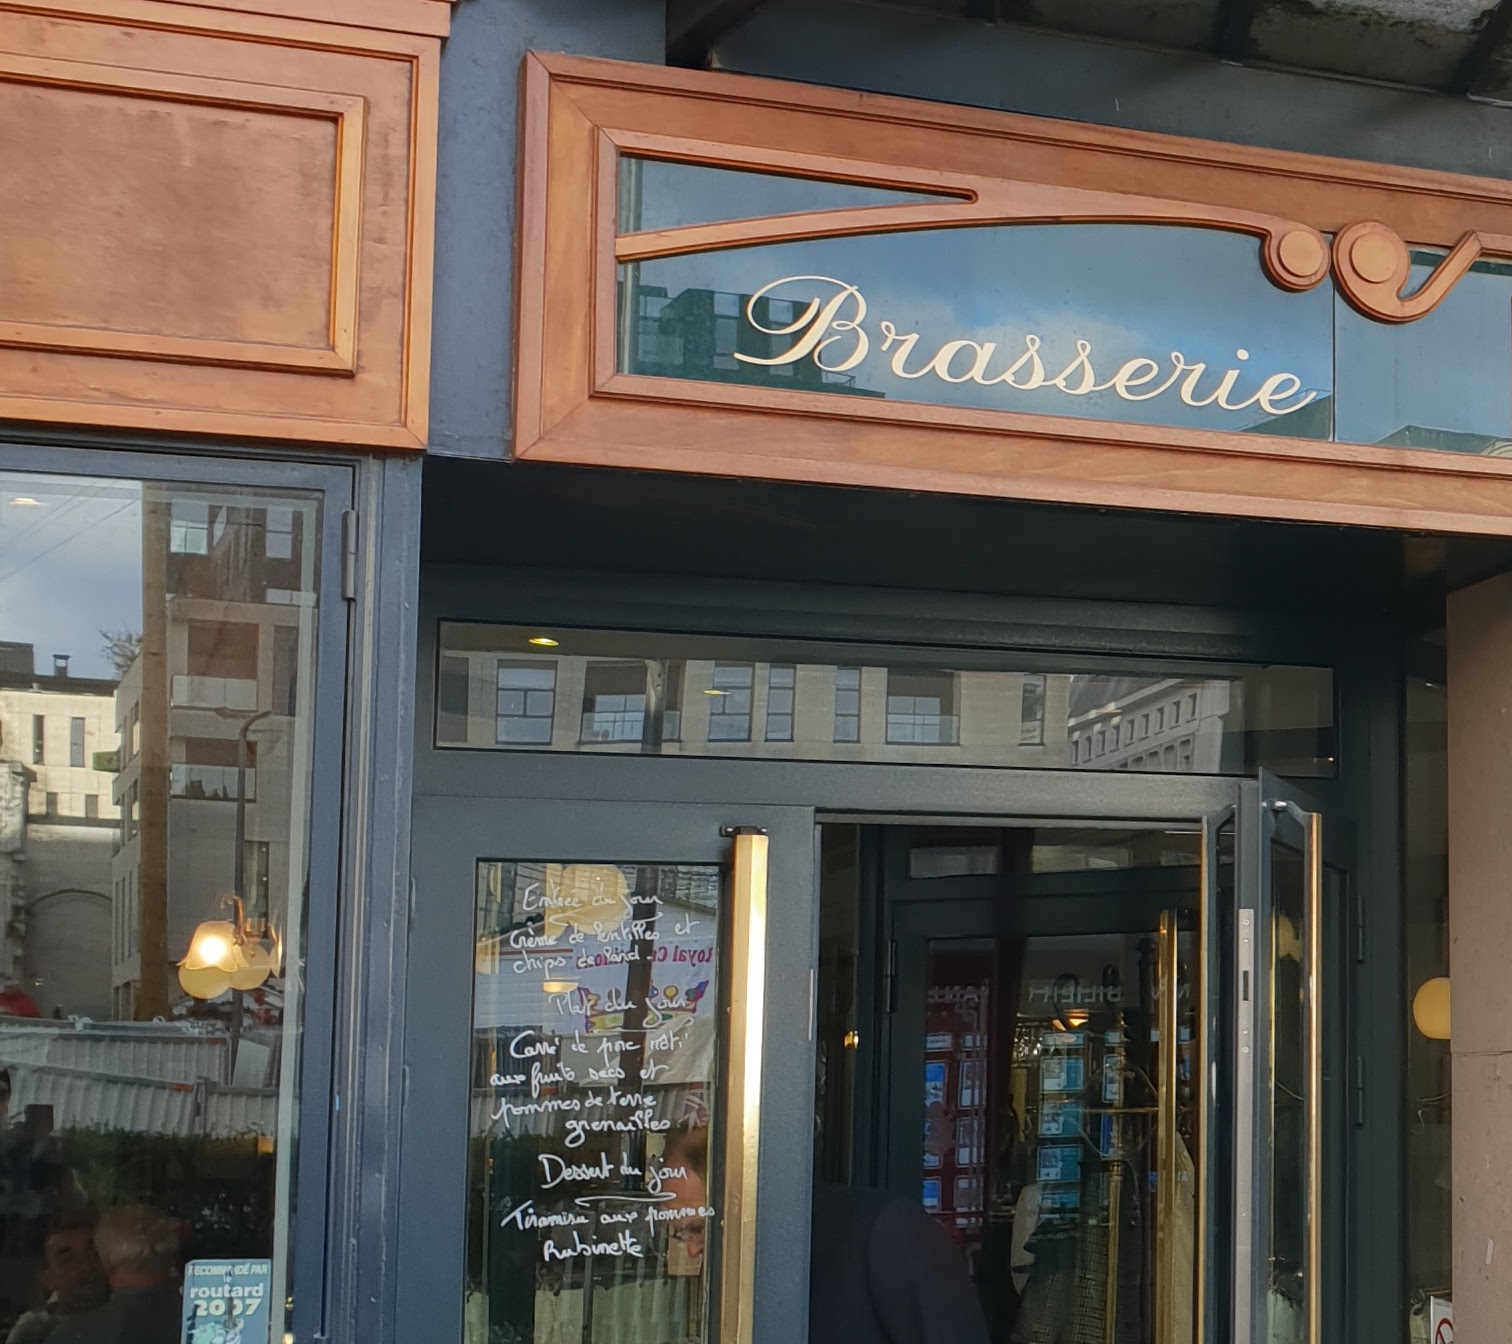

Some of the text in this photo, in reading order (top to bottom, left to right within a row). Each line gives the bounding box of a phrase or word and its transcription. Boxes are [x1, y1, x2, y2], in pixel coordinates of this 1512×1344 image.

[733, 274, 1318, 416] Brasserie
[568, 924, 585, 944] de
[674, 913, 701, 935] et
[513, 949, 567, 980] chips
[578, 948, 594, 967] de
[548, 988, 592, 1017] Plat
[604, 988, 638, 1012] du
[571, 1029, 589, 1053] de
[490, 1072, 527, 1087] aux
[639, 1058, 669, 1080] et
[491, 1097, 581, 1128] pommes
[584, 1090, 604, 1108] de
[538, 1151, 615, 1189] Dessert
[647, 1157, 689, 1194] jour
[600, 1211, 639, 1224] aux
[190, 1282, 264, 1298] routard
